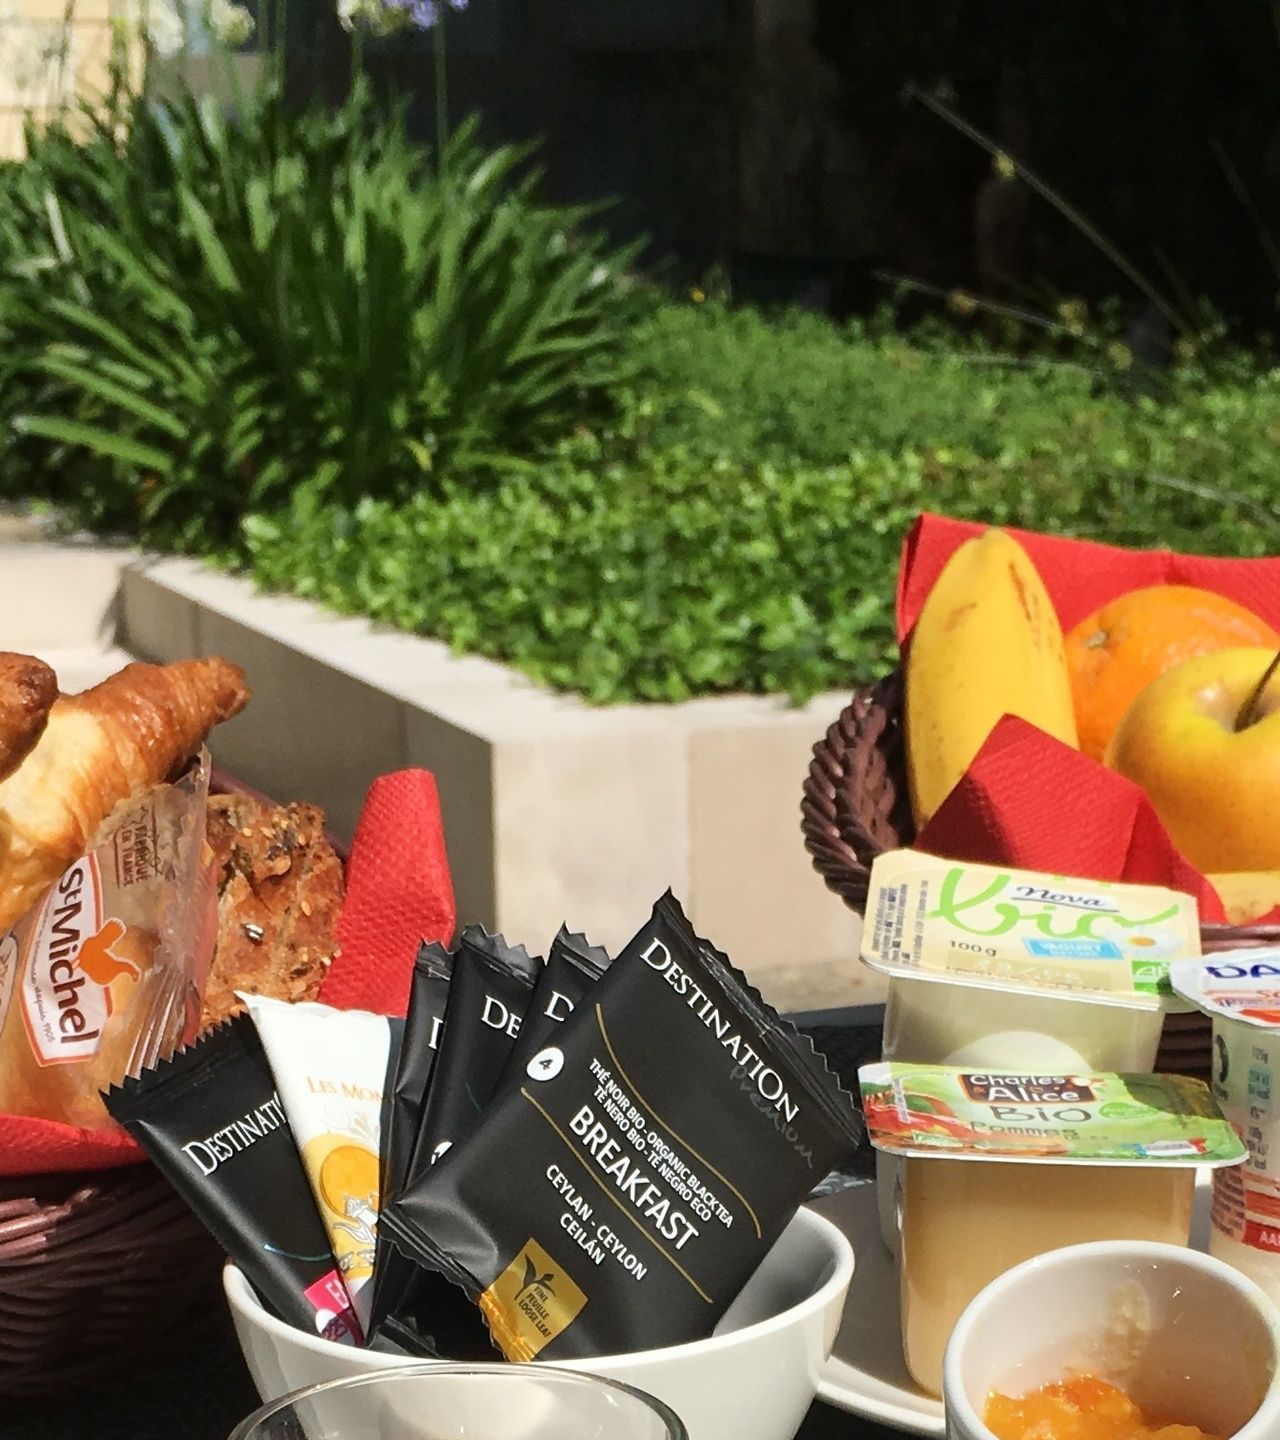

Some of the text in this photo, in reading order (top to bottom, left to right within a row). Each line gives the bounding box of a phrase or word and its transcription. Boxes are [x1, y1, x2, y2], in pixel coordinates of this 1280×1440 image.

[640, 937, 800, 1124] DESTINATION
[970, 1074, 1066, 1087] Charles
[588, 1057, 612, 1085] THÉ
[605, 1079, 631, 1111] NOIR
[626, 1106, 646, 1130] BIO
[646, 1131, 691, 1181] ORGANIC
[686, 1174, 720, 1212] BLACK
[713, 1202, 734, 1229] TEA
[970, 1121, 1079, 1137] Pommes
[988, 1086, 1081, 1101] Alice
[568, 1104, 700, 1251] BREAKFAST
[603, 1098, 631, 1132] NERO
[626, 1128, 646, 1152] BIO
[657, 1165, 693, 1202] NEGRO
[689, 1197, 712, 1222] ECO
[545, 1164, 594, 1222] CEYLAN
[596, 1224, 648, 1281] CEYLON
[559, 1212, 606, 1266] CEILÁN
